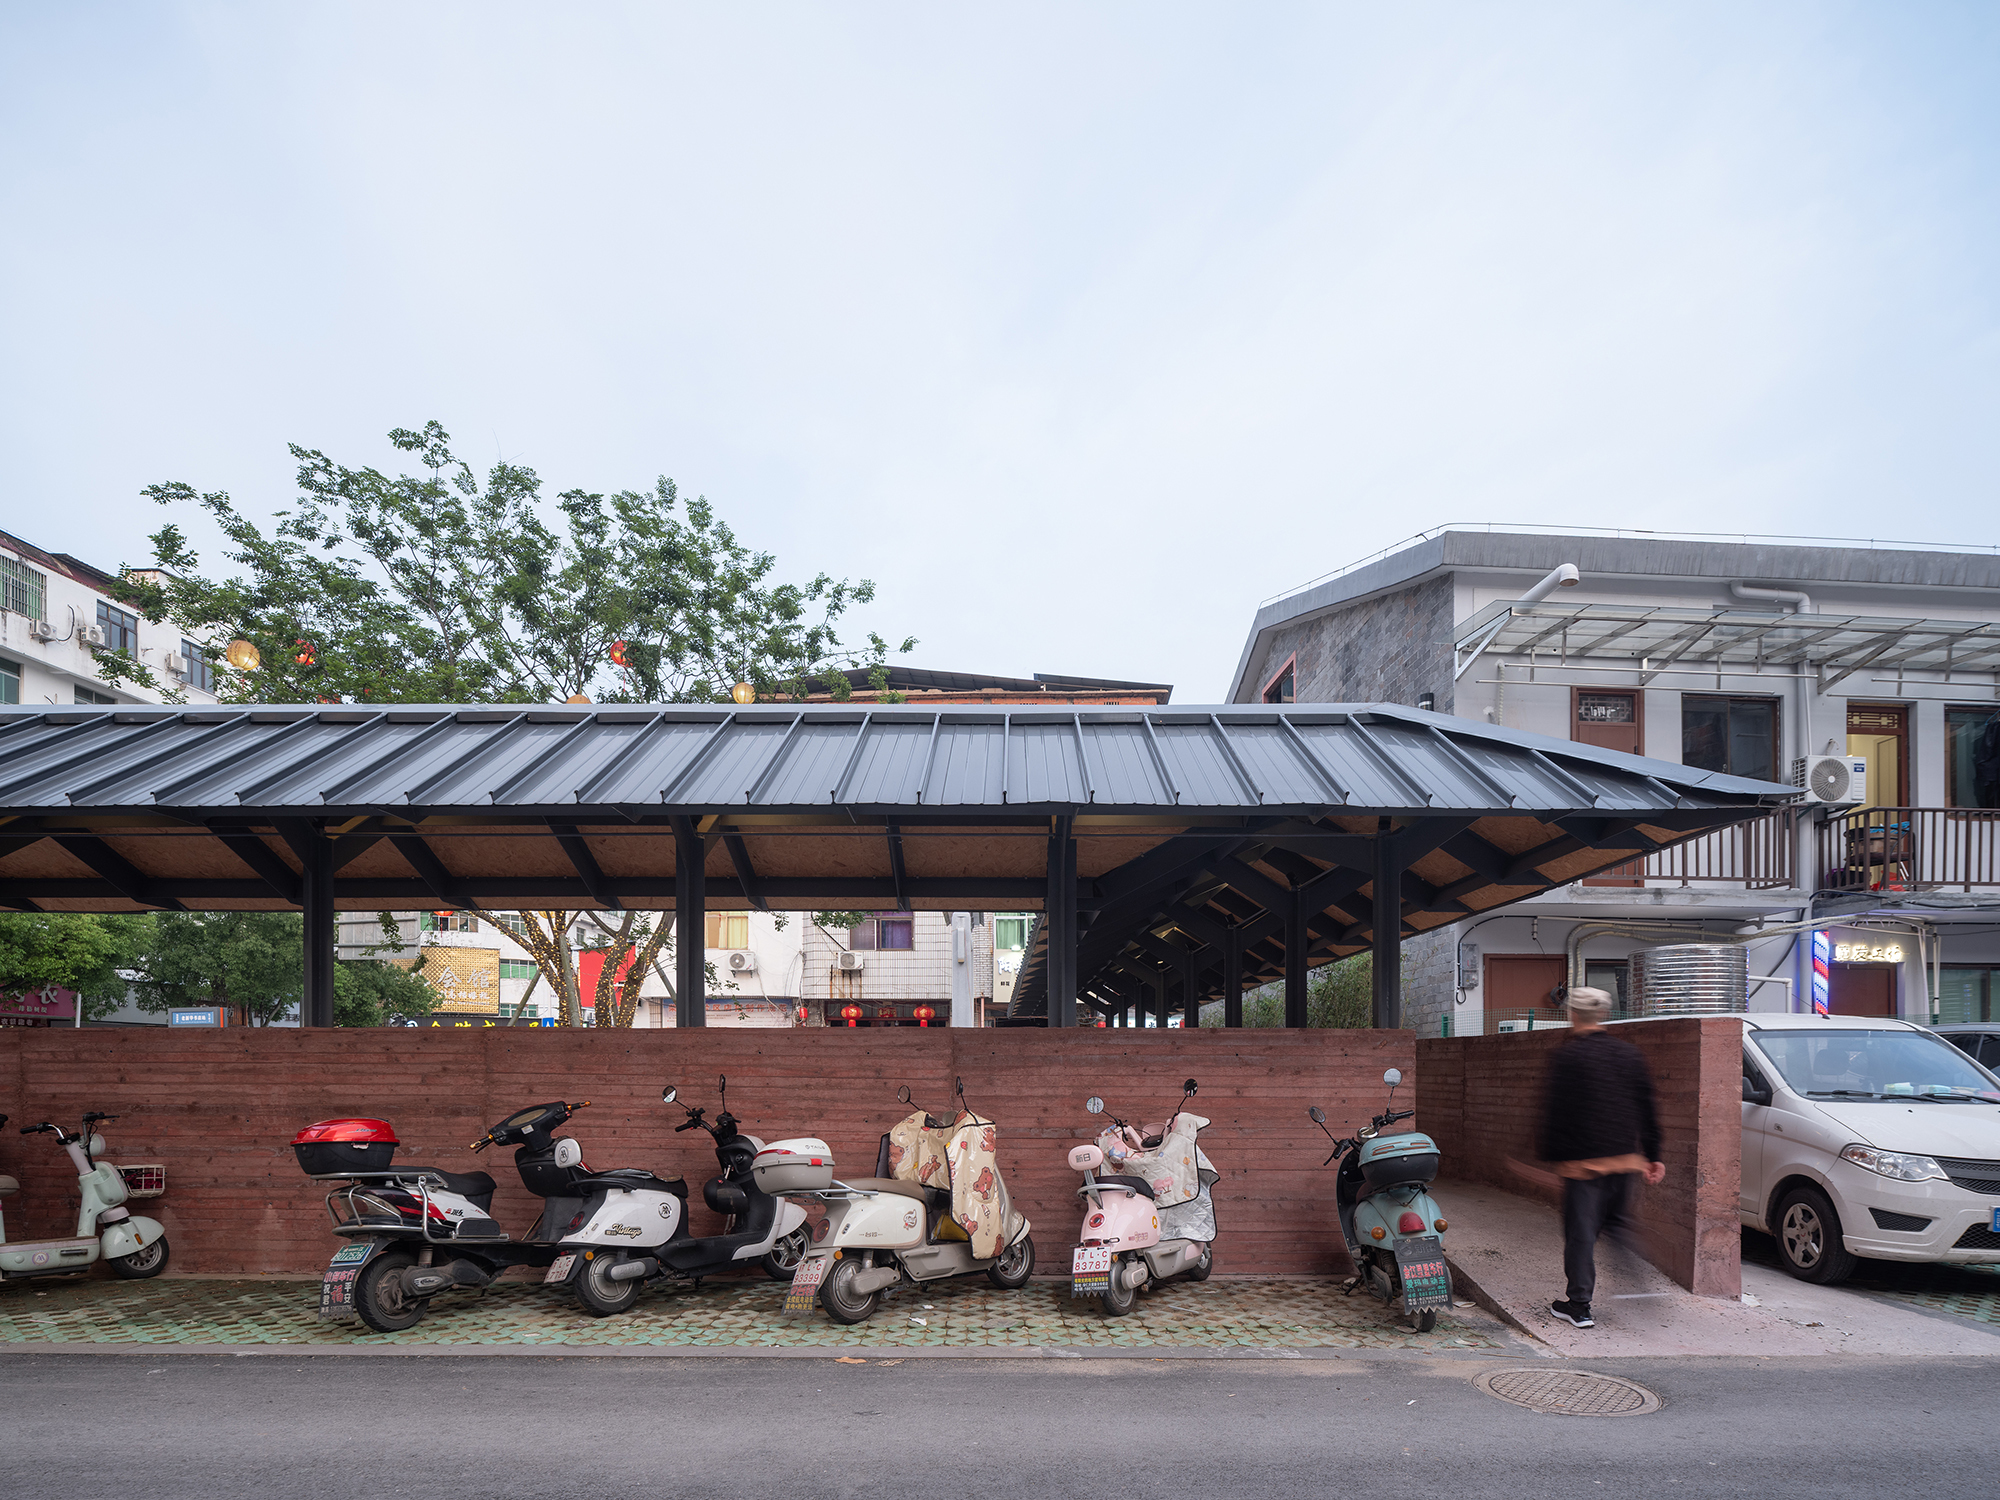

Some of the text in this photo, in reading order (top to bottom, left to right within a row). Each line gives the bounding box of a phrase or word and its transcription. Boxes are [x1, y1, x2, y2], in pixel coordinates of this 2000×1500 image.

[1075, 1153, 1091, 1163] 新日
[1075, 1261, 1108, 1271] 83787
[794, 1273, 820, 1283] 93399
[331, 1284, 344, 1304] 福
[343, 1282, 353, 1304] 平安
